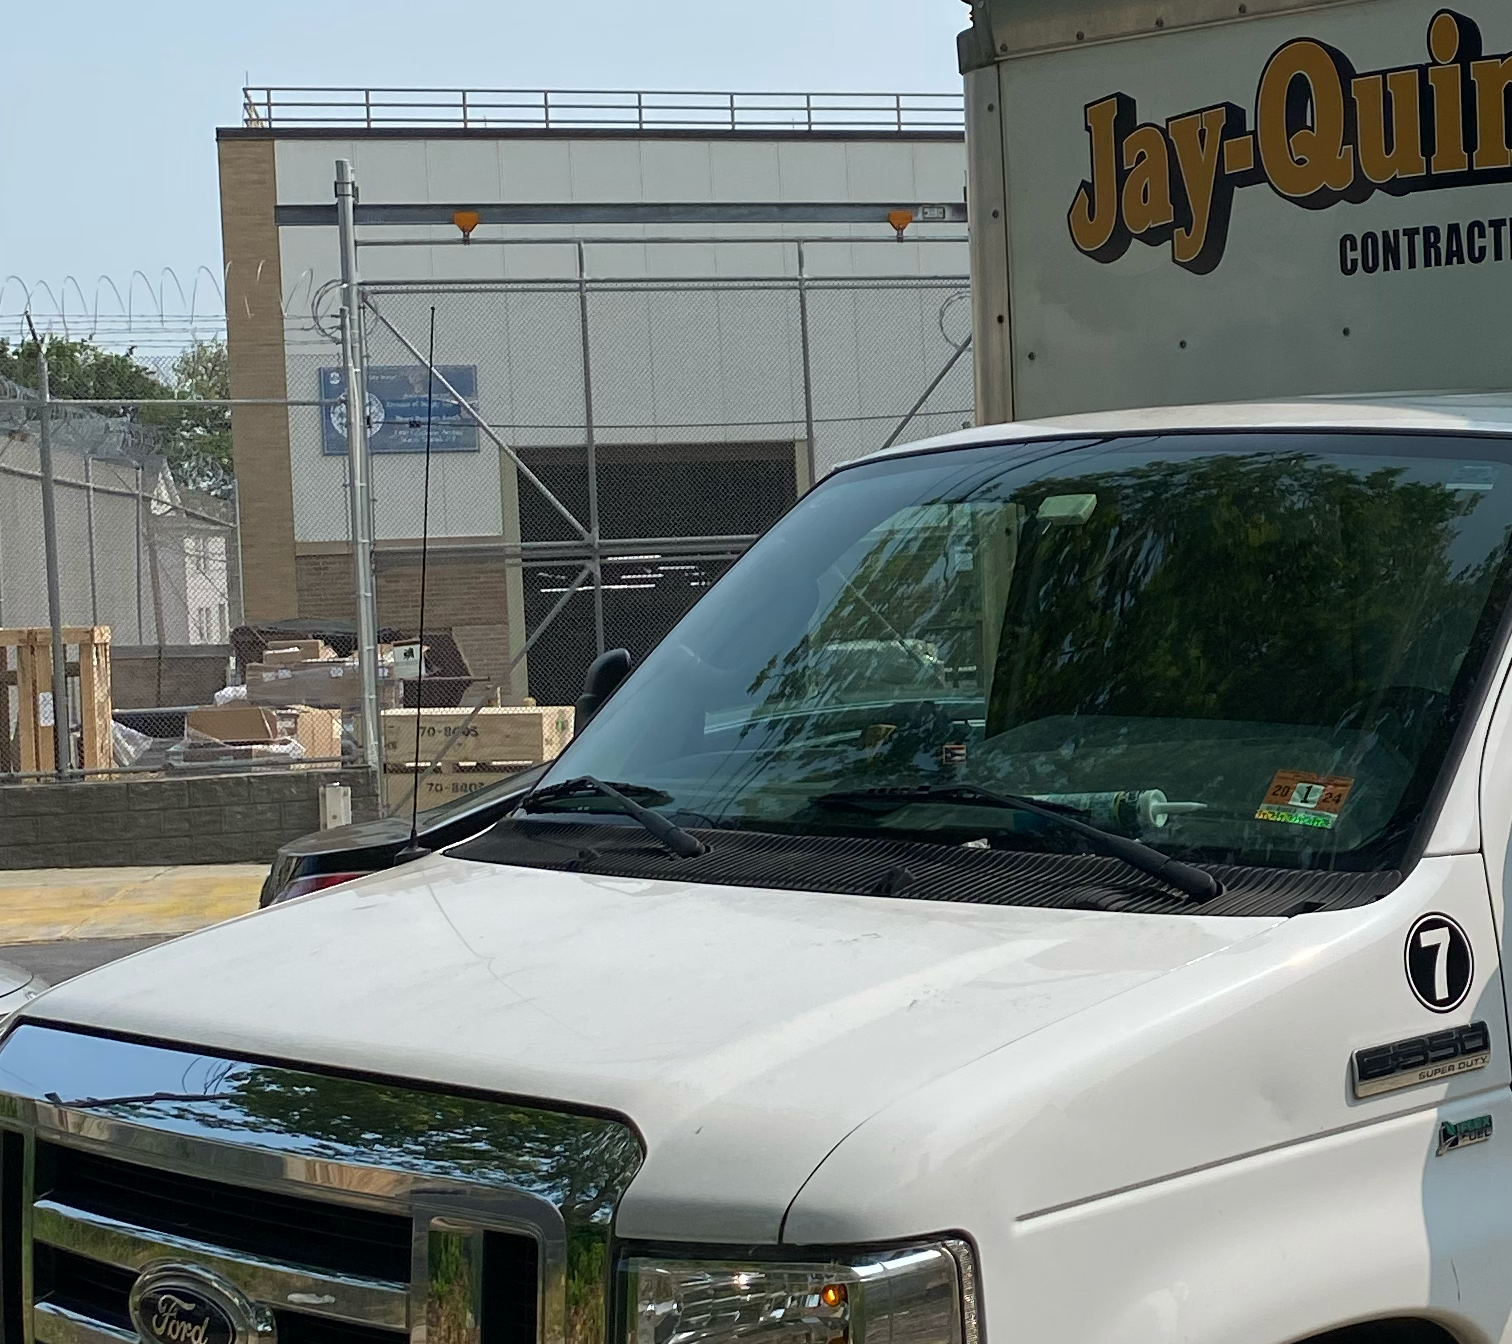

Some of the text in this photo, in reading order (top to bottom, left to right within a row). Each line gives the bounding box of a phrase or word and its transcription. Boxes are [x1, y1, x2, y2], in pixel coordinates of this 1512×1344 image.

[1271, 784, 1291, 798] 20
[1321, 792, 1343, 805] 24
[1418, 926, 1451, 1002] 7
[1418, 1055, 1489, 1081] SUPER DUTY
